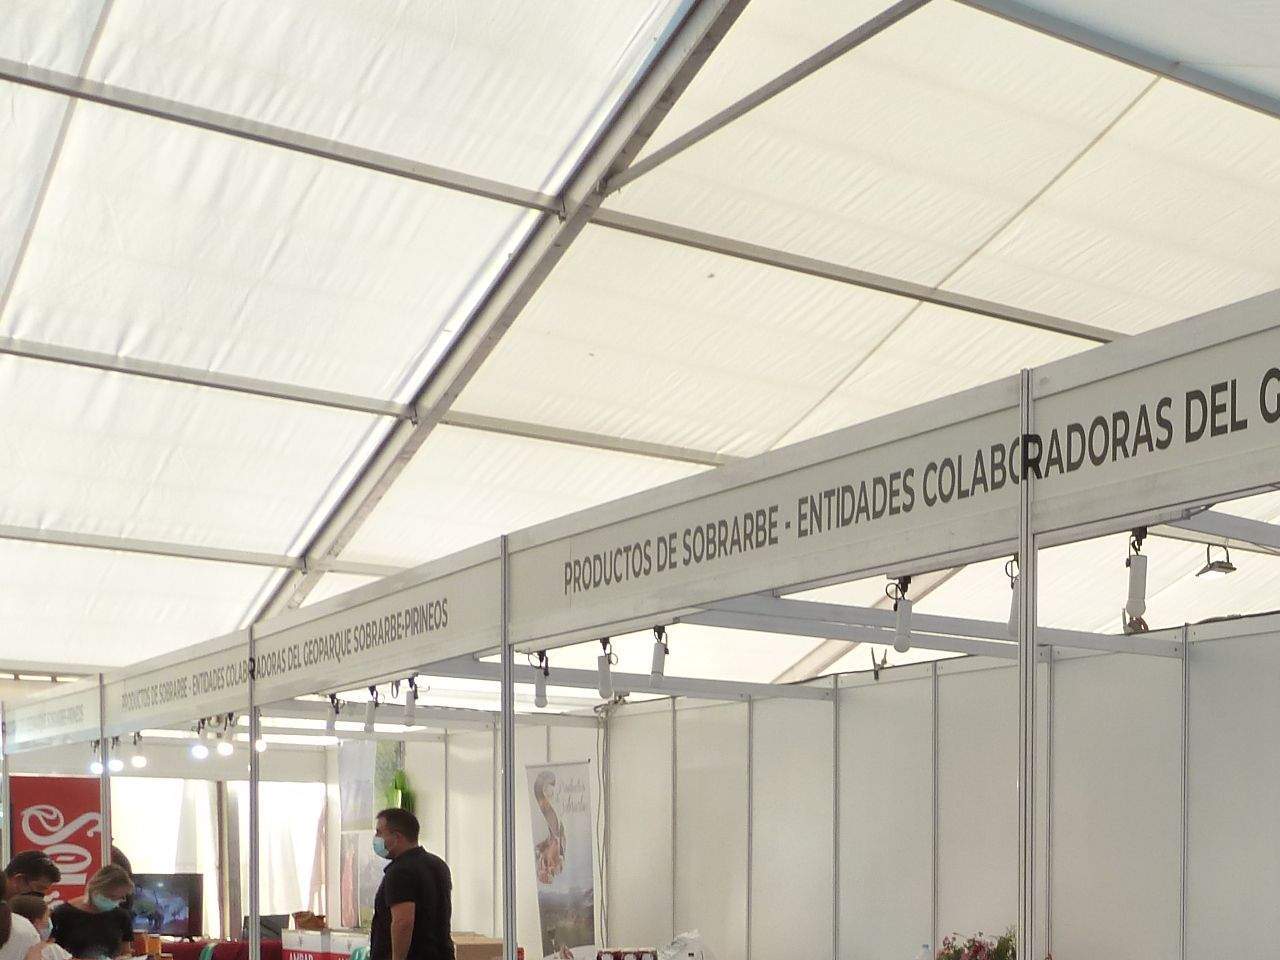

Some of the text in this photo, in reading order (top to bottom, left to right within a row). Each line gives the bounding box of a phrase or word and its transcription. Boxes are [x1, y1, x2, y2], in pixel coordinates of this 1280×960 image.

[564, 537, 652, 595] PRODUCTOS
[656, 532, 678, 572] DE
[682, 505, 778, 566] SOBRARBE
[797, 467, 915, 539] ENTIDADES
[1185, 379, 1247, 442] DEL
[192, 665, 225, 697] ENTIDADES
[287, 643, 302, 671] DEL
[303, 628, 351, 666] GEOPARQUE
[353, 597, 449, 653] SOBRARBE-PIRINEOS
